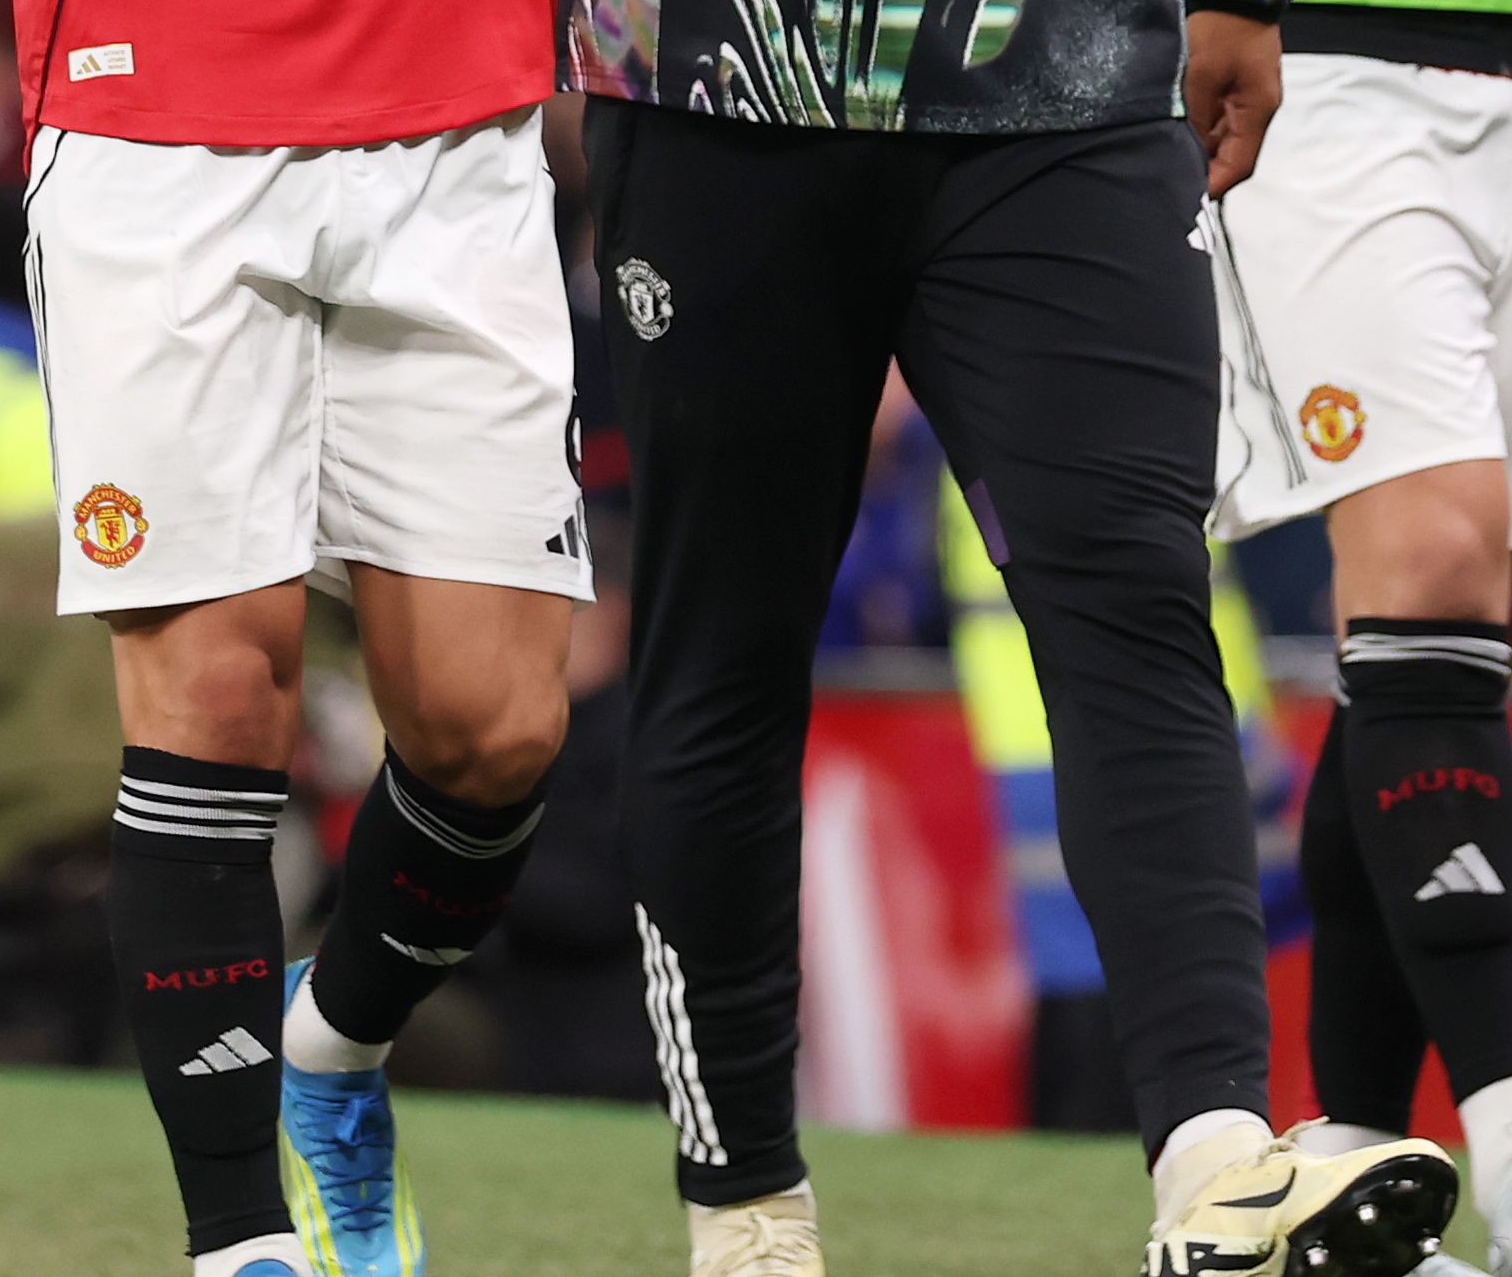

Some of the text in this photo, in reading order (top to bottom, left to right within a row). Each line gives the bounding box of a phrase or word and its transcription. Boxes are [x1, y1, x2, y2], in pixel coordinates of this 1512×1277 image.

[79, 489, 137, 519] MANCHESTER
[93, 546, 136, 564] UNITED
[145, 957, 269, 993] MUFC
